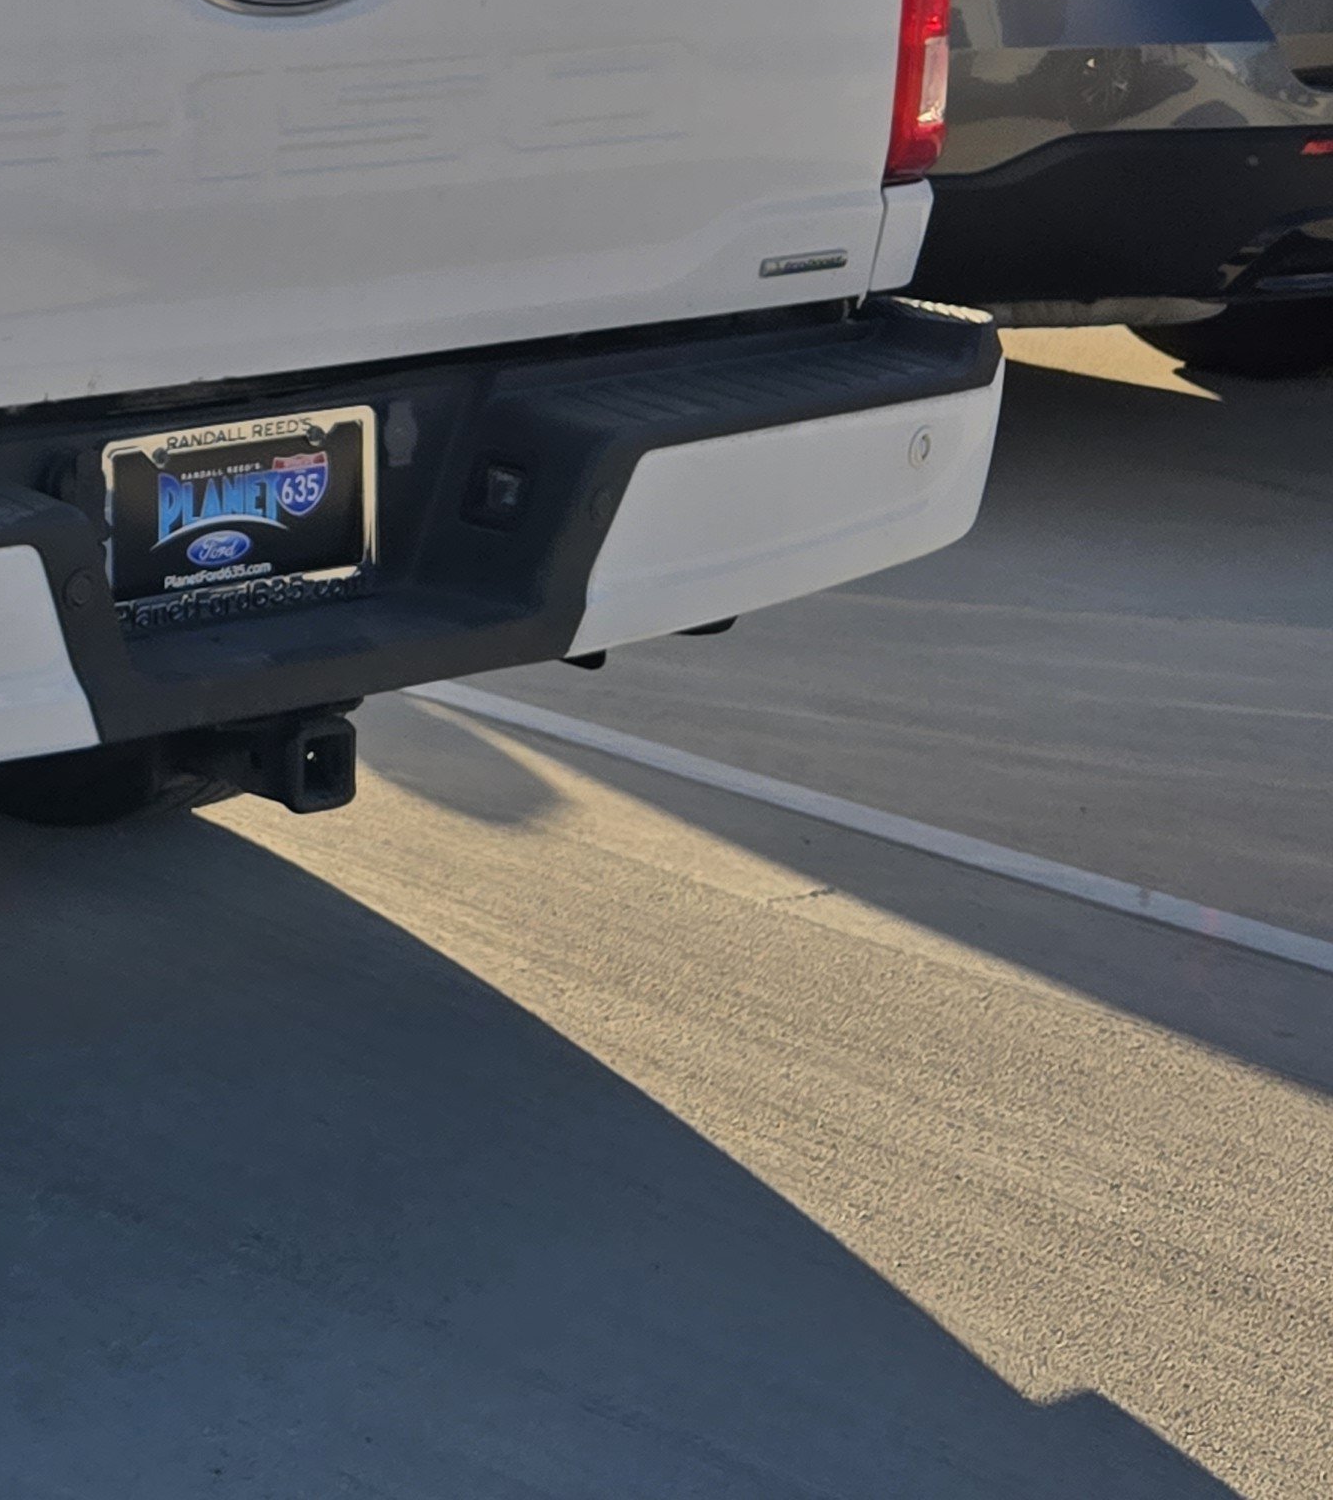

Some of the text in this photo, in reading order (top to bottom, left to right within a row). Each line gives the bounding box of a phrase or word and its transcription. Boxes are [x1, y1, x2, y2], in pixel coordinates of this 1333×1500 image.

[166, 417, 313, 450] RANDALL REED'S
[281, 473, 321, 505] 635
[158, 469, 280, 543] PLANET
[199, 537, 237, 561] Ford
[163, 561, 273, 590] PlanetFord635.com
